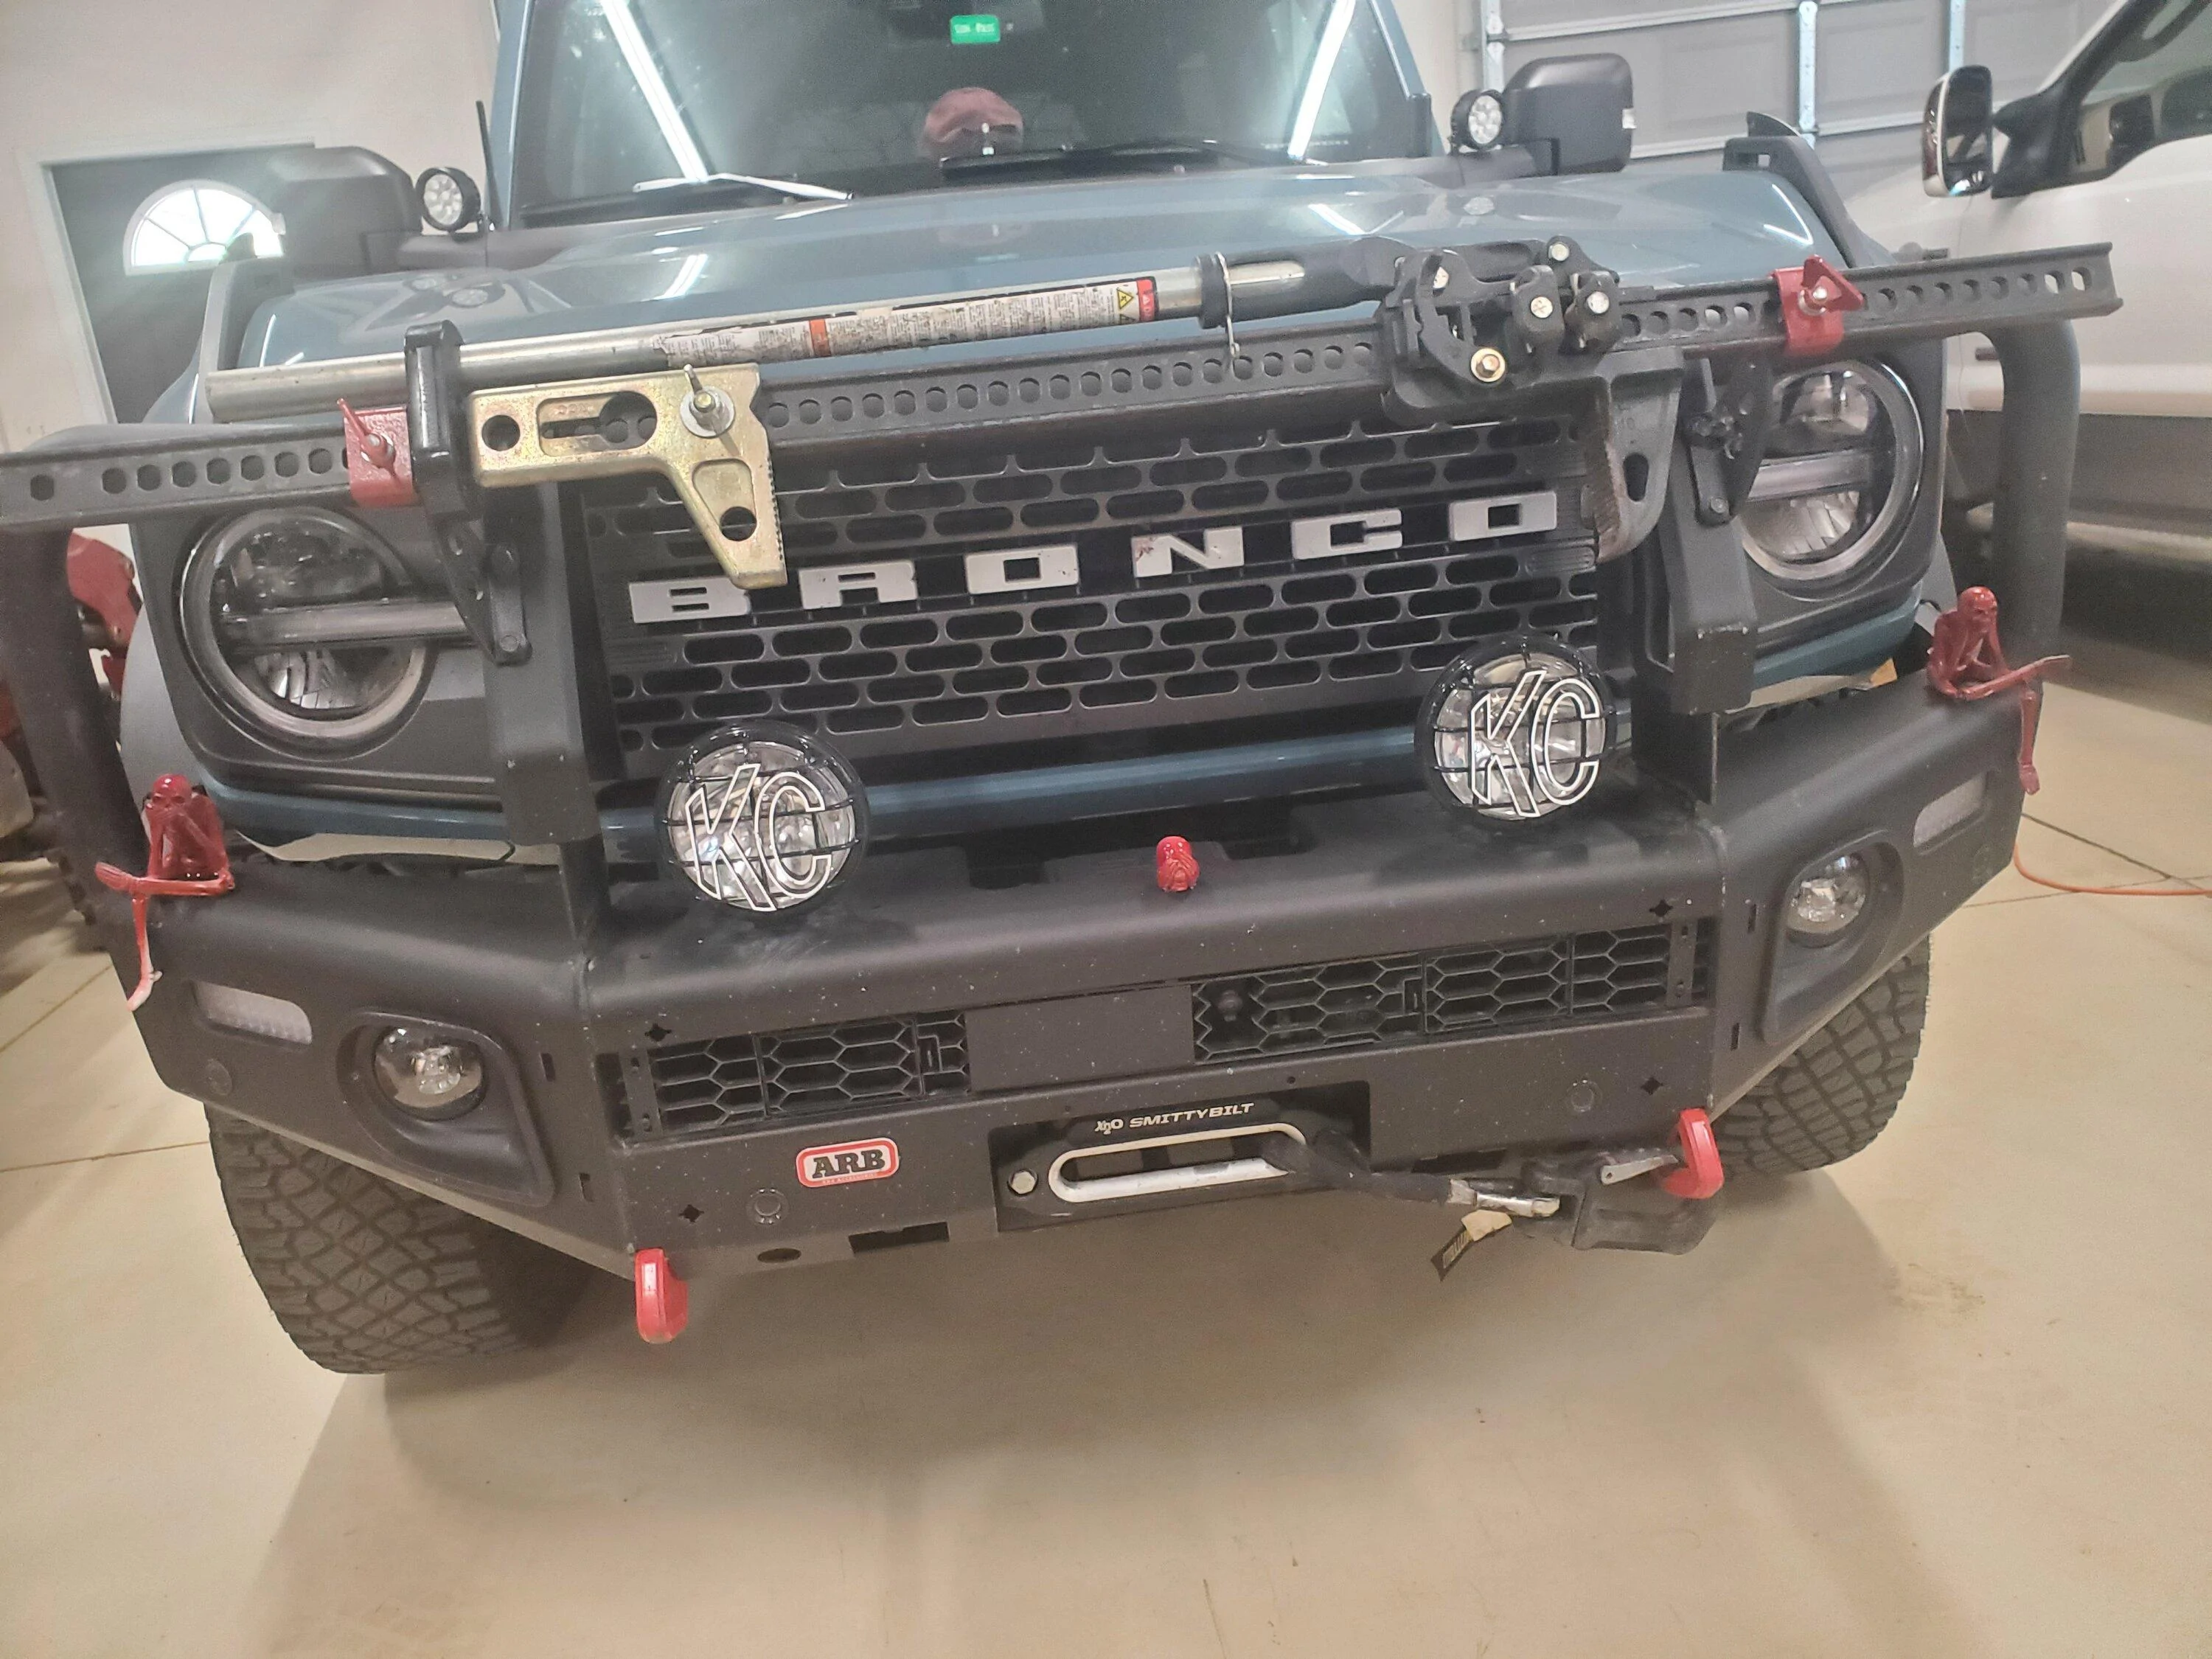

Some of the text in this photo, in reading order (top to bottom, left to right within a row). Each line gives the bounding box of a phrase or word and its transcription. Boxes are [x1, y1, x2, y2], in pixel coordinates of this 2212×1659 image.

[629, 490, 1558, 625] BRONCO
[1471, 669, 1600, 818] KC
[685, 762, 832, 911] KC
[813, 1150, 886, 1178] ARB
[1129, 1102, 1255, 1128] SMITTYBILT
